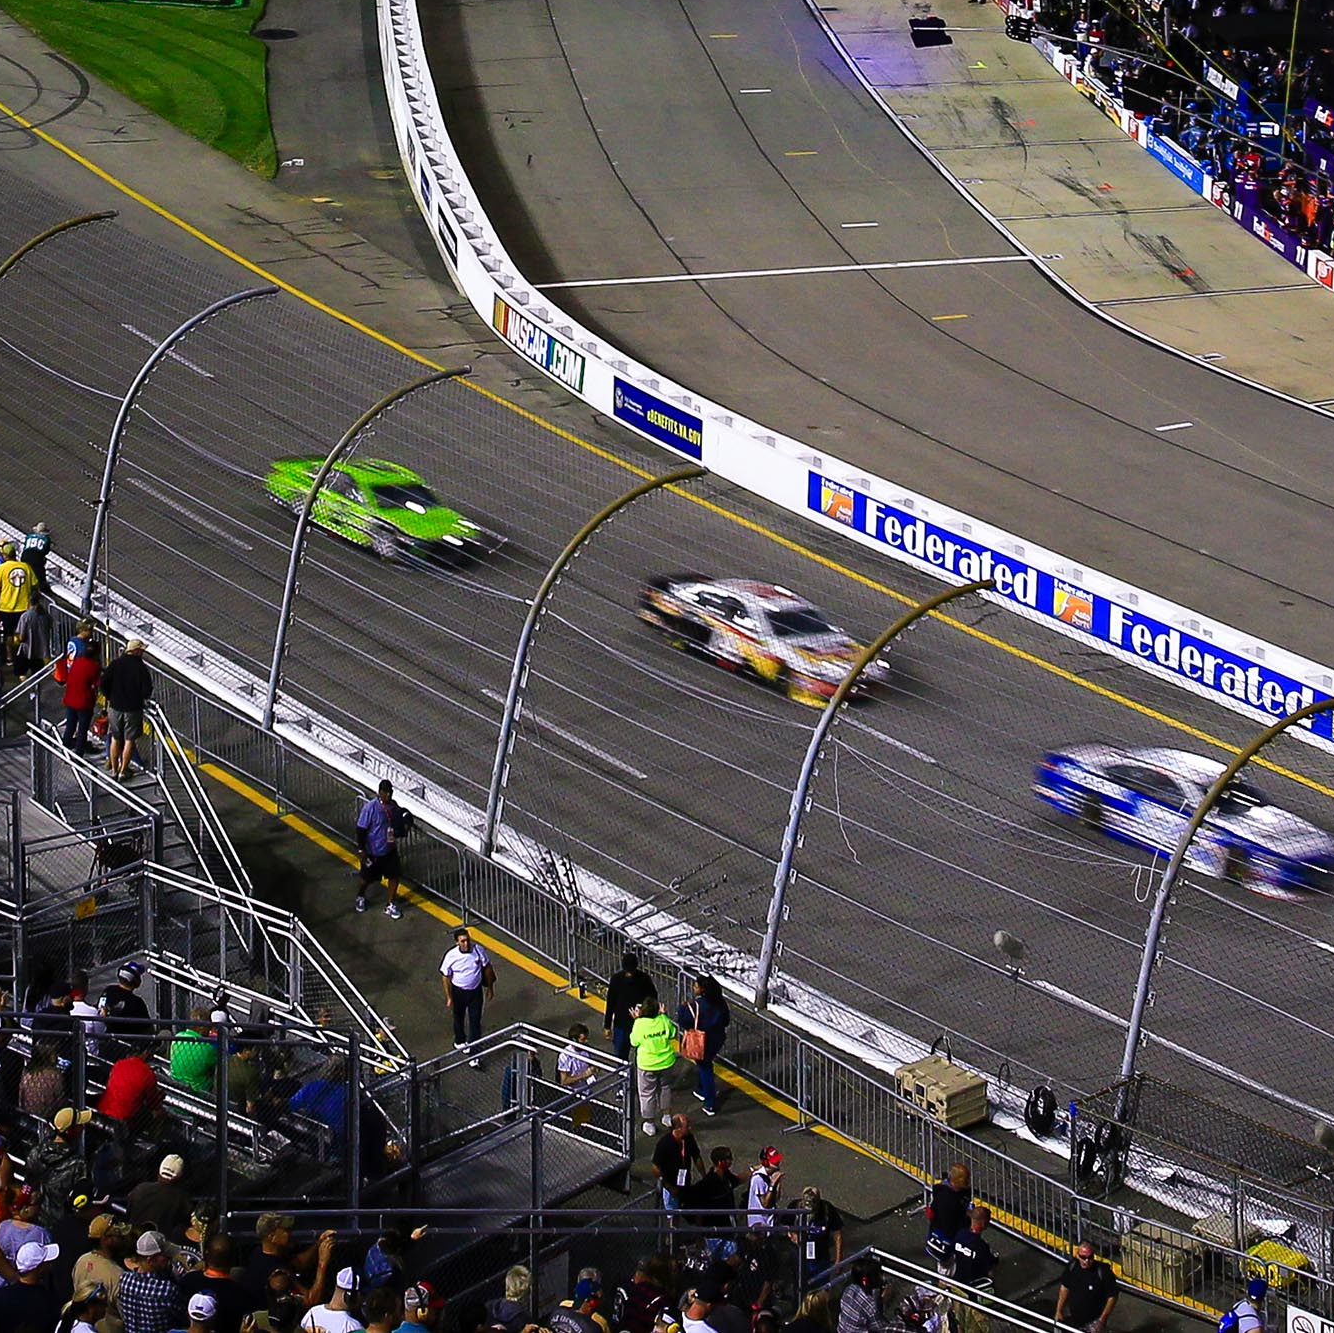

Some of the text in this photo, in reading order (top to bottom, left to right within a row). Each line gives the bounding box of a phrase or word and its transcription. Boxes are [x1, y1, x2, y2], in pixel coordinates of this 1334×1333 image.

[821, 477, 854, 498] Federated
[865, 497, 1038, 607] Federated
[1054, 578, 1094, 603] Federated
[1108, 602, 1315, 730] Federated
